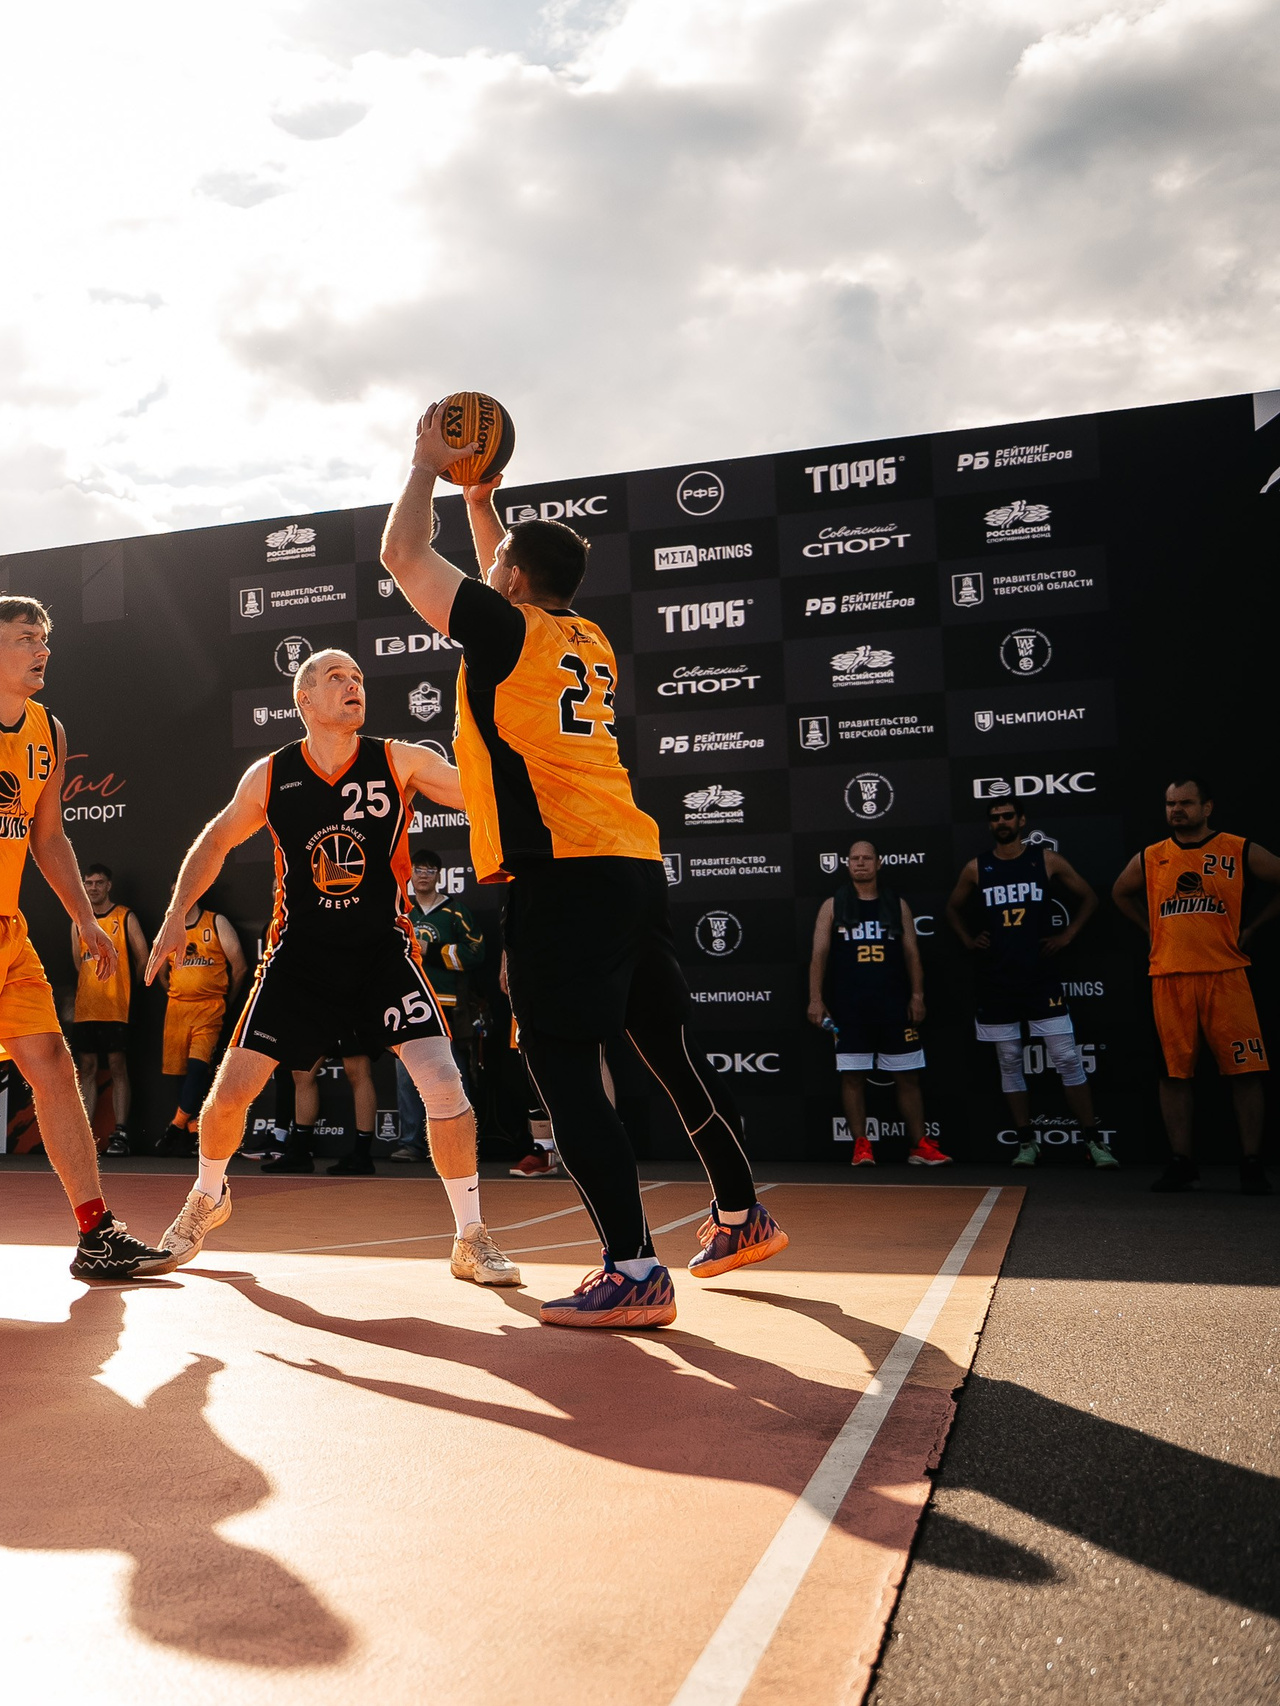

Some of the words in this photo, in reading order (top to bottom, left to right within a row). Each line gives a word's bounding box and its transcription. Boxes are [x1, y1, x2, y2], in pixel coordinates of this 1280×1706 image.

[995, 443, 1049, 458] РЕЙТИНГ
[994, 450, 1073, 467] БУКМЕКЕРОВ
[805, 457, 896, 493] ТОФБ
[683, 486, 718, 499] РФБ
[540, 496, 608, 520] DKC
[819, 523, 898, 540] Советский
[986, 524, 1051, 538] РОССИЙСКИЙ
[802, 534, 911, 557] СПОРТ
[993, 570, 1076, 585] ПРАВИТЕЛЬСТВО
[271, 585, 334, 598] ПРАВИТЕЛЬСТВО
[993, 583, 1044, 595] ТВЕРСКОЙ
[1047, 579, 1093, 591] ОБЛАСТИ
[271, 596, 310, 608] ТВЕРСКОЙ
[311, 593, 346, 603] ОБЛАСТИ
[841, 591, 893, 604] РЕЙТИНГ
[840, 598, 915, 613] БУКМЕКЕРОВ
[657, 600, 745, 633] ТОФБ
[408, 632, 463, 653] DK
[673, 665, 748, 679] Советский
[832, 669, 894, 682] РОССИЙСКИЙ
[657, 676, 761, 696] СПОРТ
[838, 716, 918, 729] ПРАВИТЕЛЬСТВО
[996, 708, 1085, 725] ЧЕМПИОНАТ
[694, 732, 744, 743] РЕЙТИНГ
[838, 727, 887, 739] ТВЕРСКОЙ
[889, 725, 934, 736] ОБЛАСТИ
[693, 739, 764, 752] БУКМЕКЕРОВ
[26, 743, 52, 781] 13
[1014, 772, 1096, 796] DKC
[341, 781, 391, 821] 25
[685, 810, 744, 820] РОССИЙСКИЙ
[305, 824, 339, 851] ВЕТЕРАНЫ
[341, 824, 367, 843] БАСКЕТ
[690, 855, 766, 866] ПРАВИТЕЛЬСТВО
[840, 853, 925, 867] ЧИОНАТ
[1203, 853, 1235, 879] 24
[690, 866, 736, 877] ТВЕРСКОЙ
[738, 865, 781, 875] ОБЛАСТИ
[983, 882, 1043, 906] ТВЕРЬ
[318, 896, 360, 909] ТВЕРЬ
[1002, 908, 1026, 927] 17
[857, 945, 884, 962] 25
[690, 991, 772, 1002] ЧЕМПИОНАТ
[1061, 981, 1104, 997] TINGS
[1231, 1038, 1264, 1065] 24
